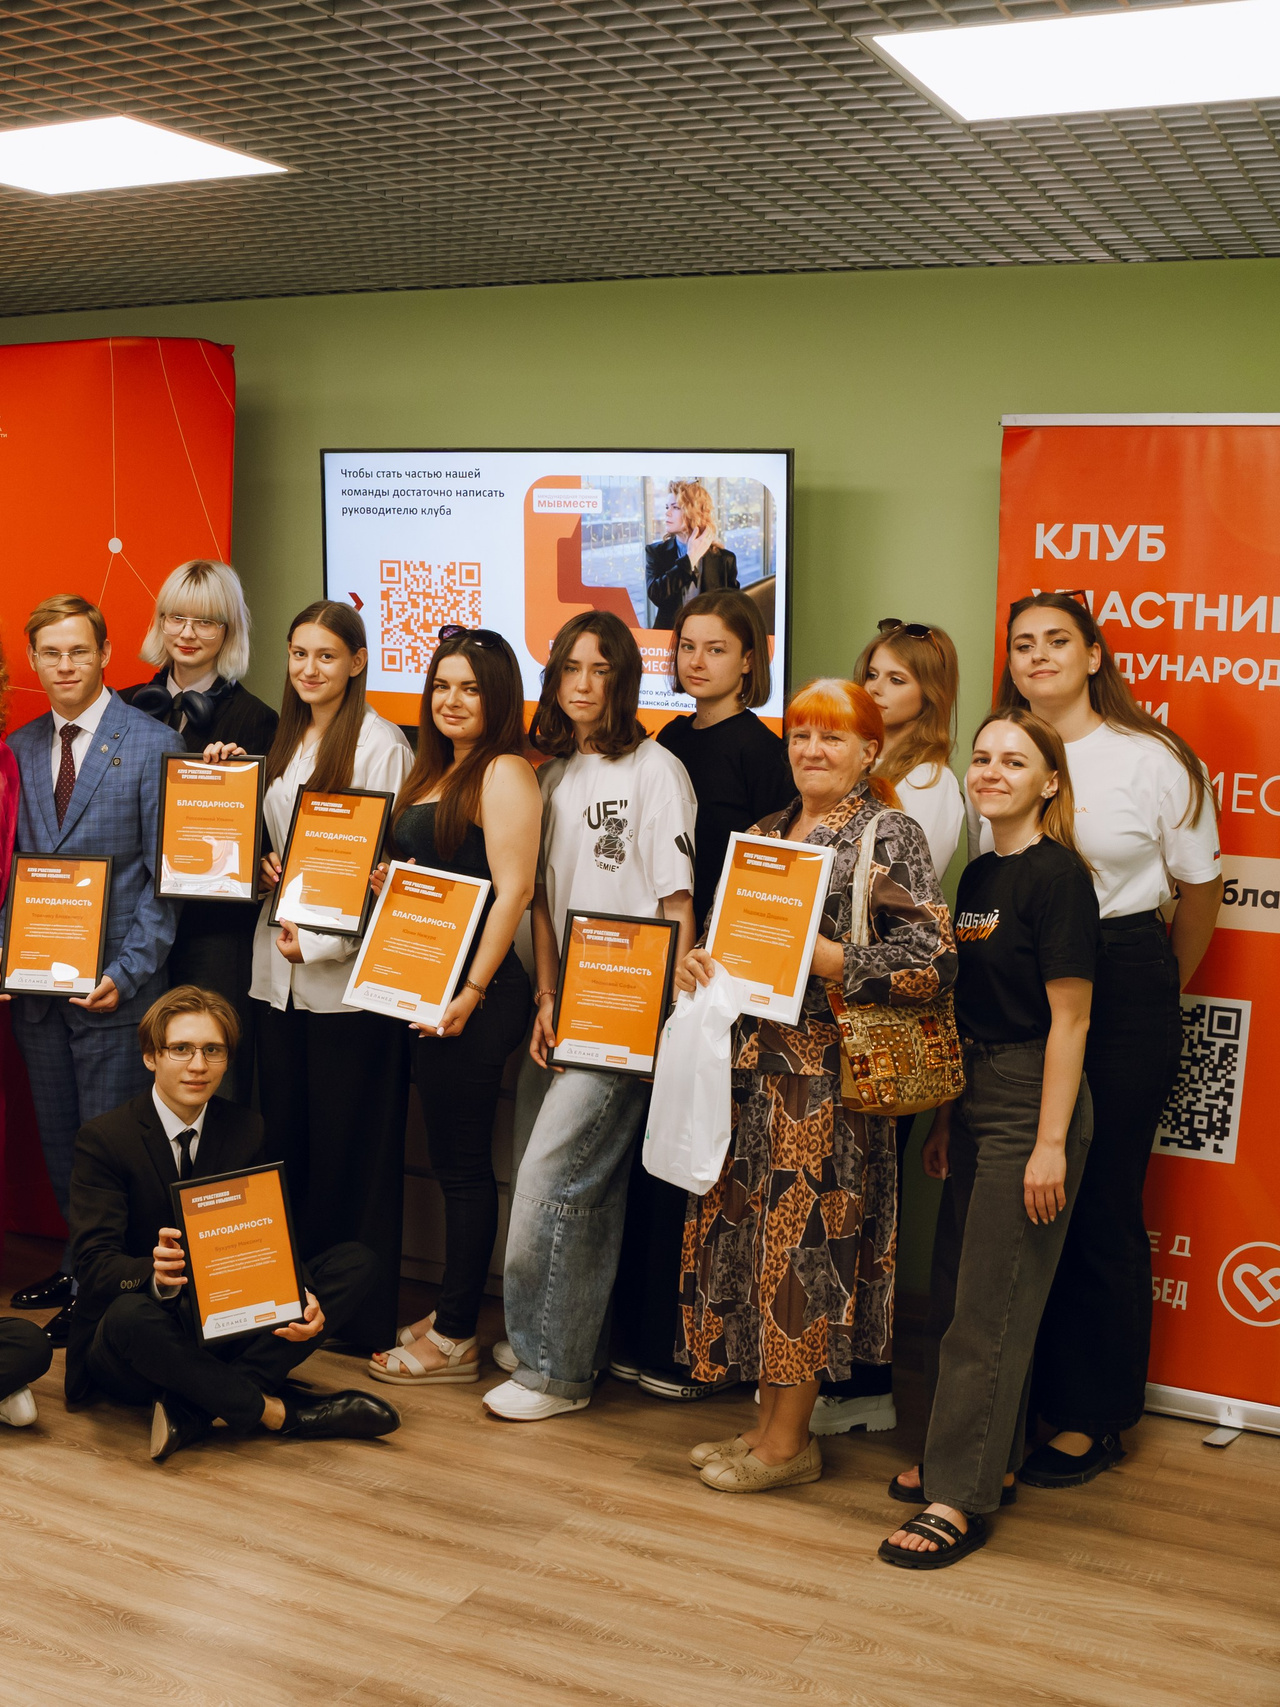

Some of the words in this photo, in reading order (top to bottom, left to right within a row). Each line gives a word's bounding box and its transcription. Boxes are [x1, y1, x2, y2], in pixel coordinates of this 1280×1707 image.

[340, 467, 373, 479] Чтобы
[376, 470, 403, 479] стать
[404, 470, 442, 480] частью
[445, 468, 481, 479] нашей
[341, 488, 390, 500] команды
[392, 488, 453, 500] достаточно
[455, 488, 505, 499] написать
[341, 505, 418, 519] руководителю
[420, 503, 452, 517] клуба
[537, 500, 599, 509] мывместе
[1034, 523, 1166, 562] КЛУБ
[1031, 588, 1280, 634] АСТНИ
[1113, 652, 1280, 691] ДУНАРОД
[639, 700, 670, 708] язанской
[176, 799, 245, 809] БЛАГОДАРНОСТЬ
[305, 830, 368, 844] БЛАГОДАРНОСТЬ
[25, 897, 93, 907] БЛАГОДАРНОСТЬ
[736, 887, 804, 907] БЛАГОДАРНОСТЬ
[391, 909, 457, 931] БЛАГОДАРНОСТЬ
[578, 960, 652, 977] БЛАГОДАРНОСТЬ
[198, 1216, 274, 1240] БЛАГОДАРНОСТЬ
[1151, 1276, 1189, 1311] БЕД
